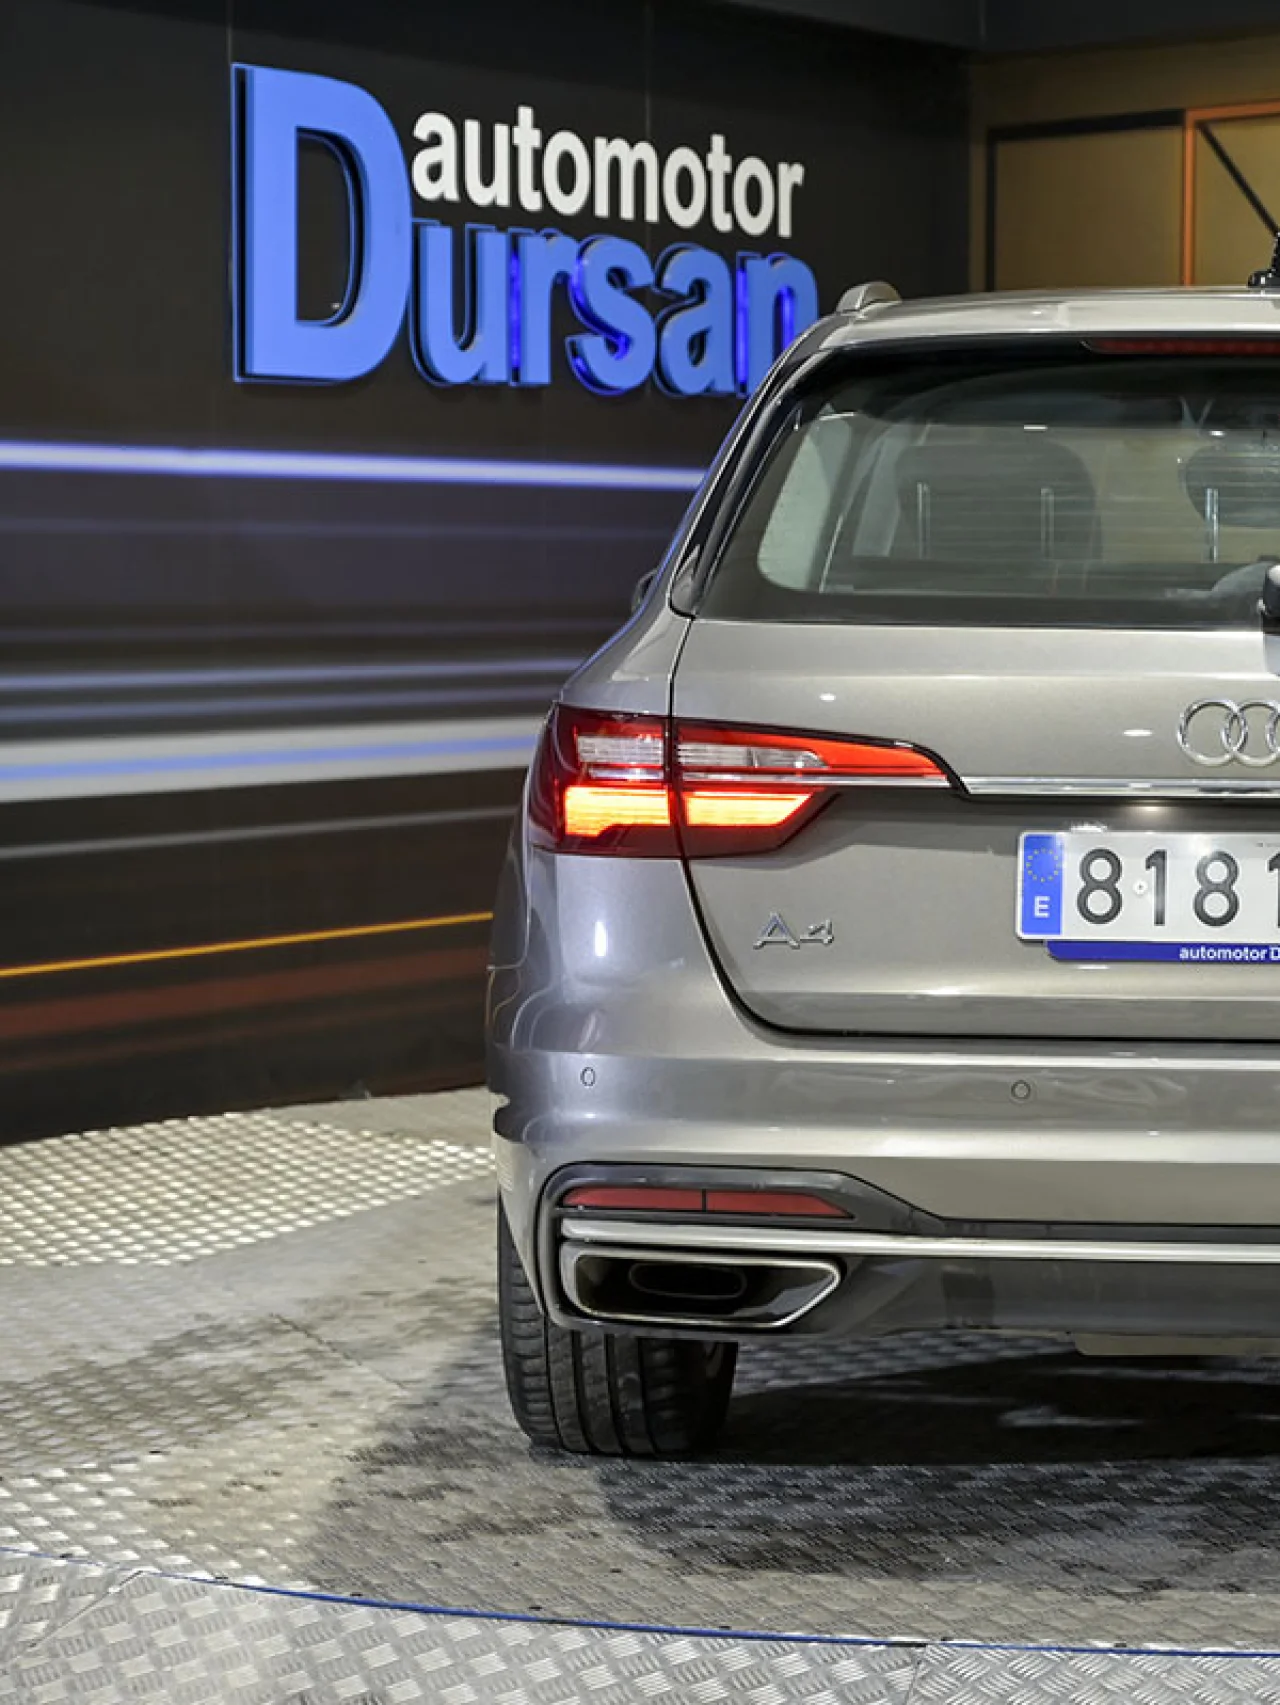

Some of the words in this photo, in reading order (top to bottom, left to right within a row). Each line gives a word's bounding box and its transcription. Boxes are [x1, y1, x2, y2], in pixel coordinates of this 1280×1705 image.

[411, 105, 804, 238] automotor
[231, 62, 818, 397] Dursan
[752, 911, 834, 951] A4
[1033, 896, 1049, 918] E
